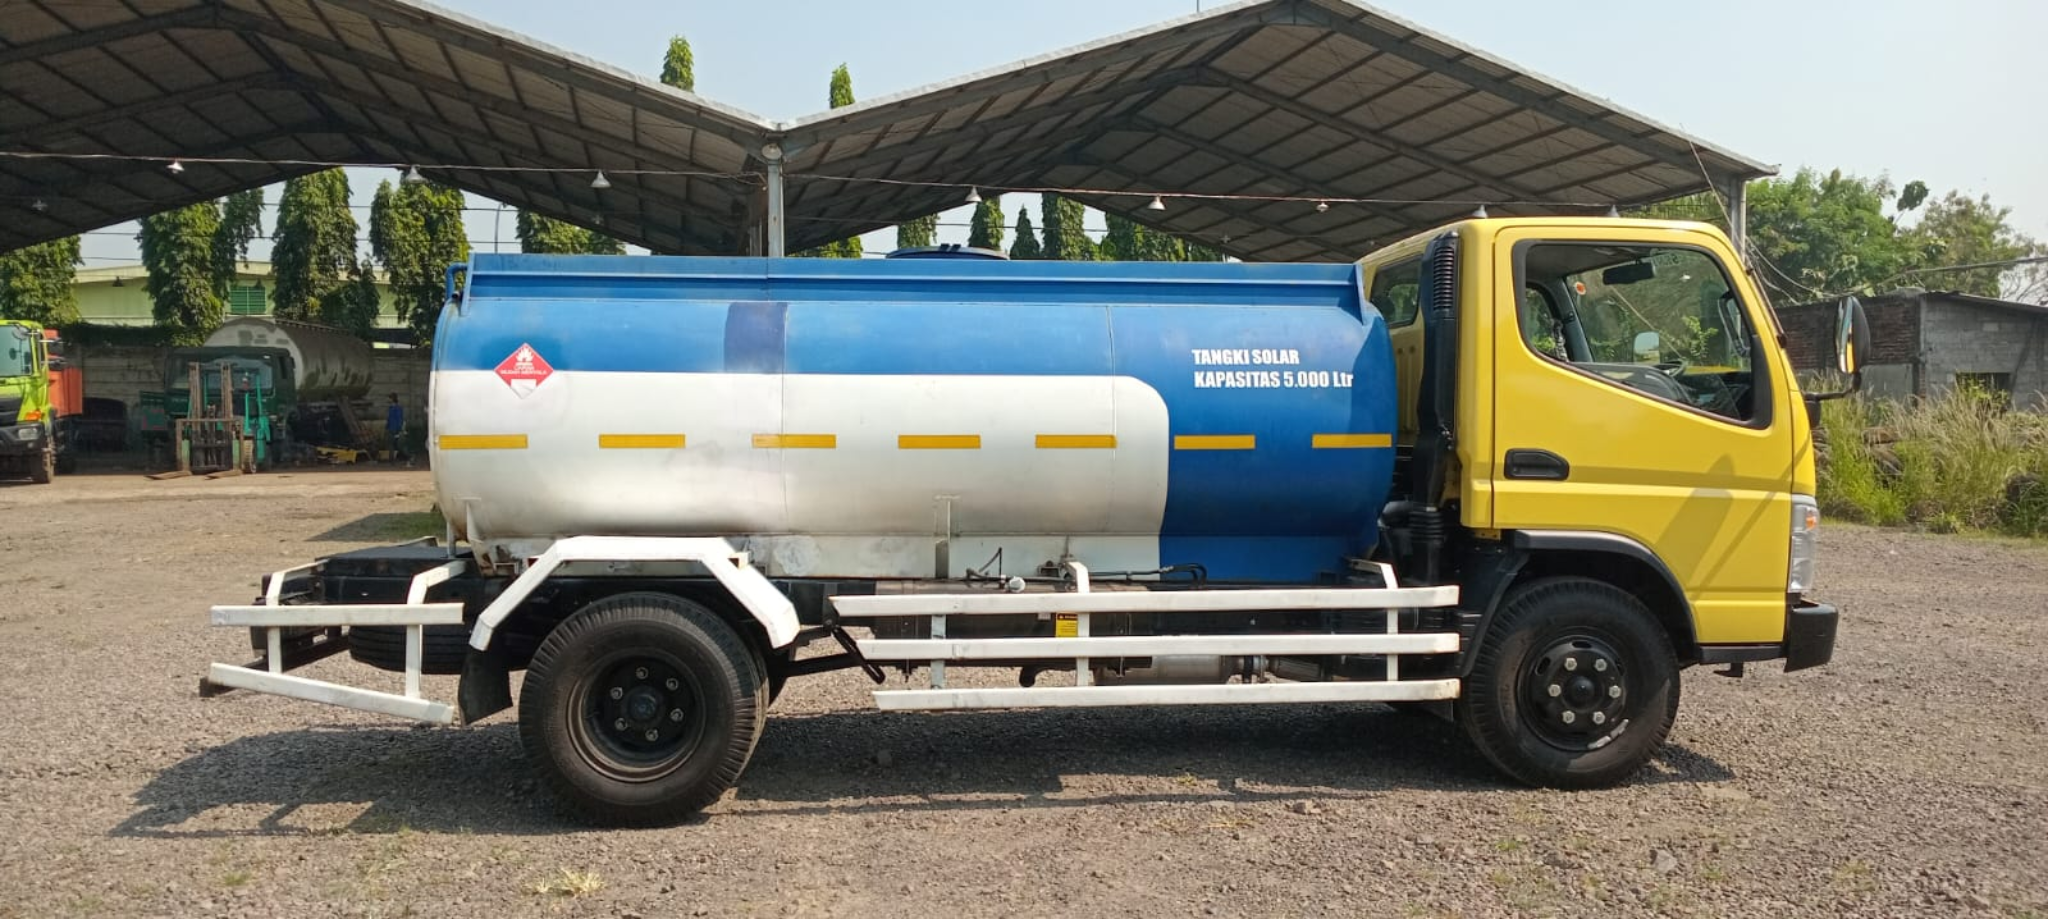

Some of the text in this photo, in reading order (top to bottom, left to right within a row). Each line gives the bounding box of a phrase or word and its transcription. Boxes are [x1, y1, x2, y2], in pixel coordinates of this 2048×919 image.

[1192, 349, 1300, 364] TANGKI SOLAR
[1194, 371, 1354, 388] KAPASITAS 5.000 Ltr
